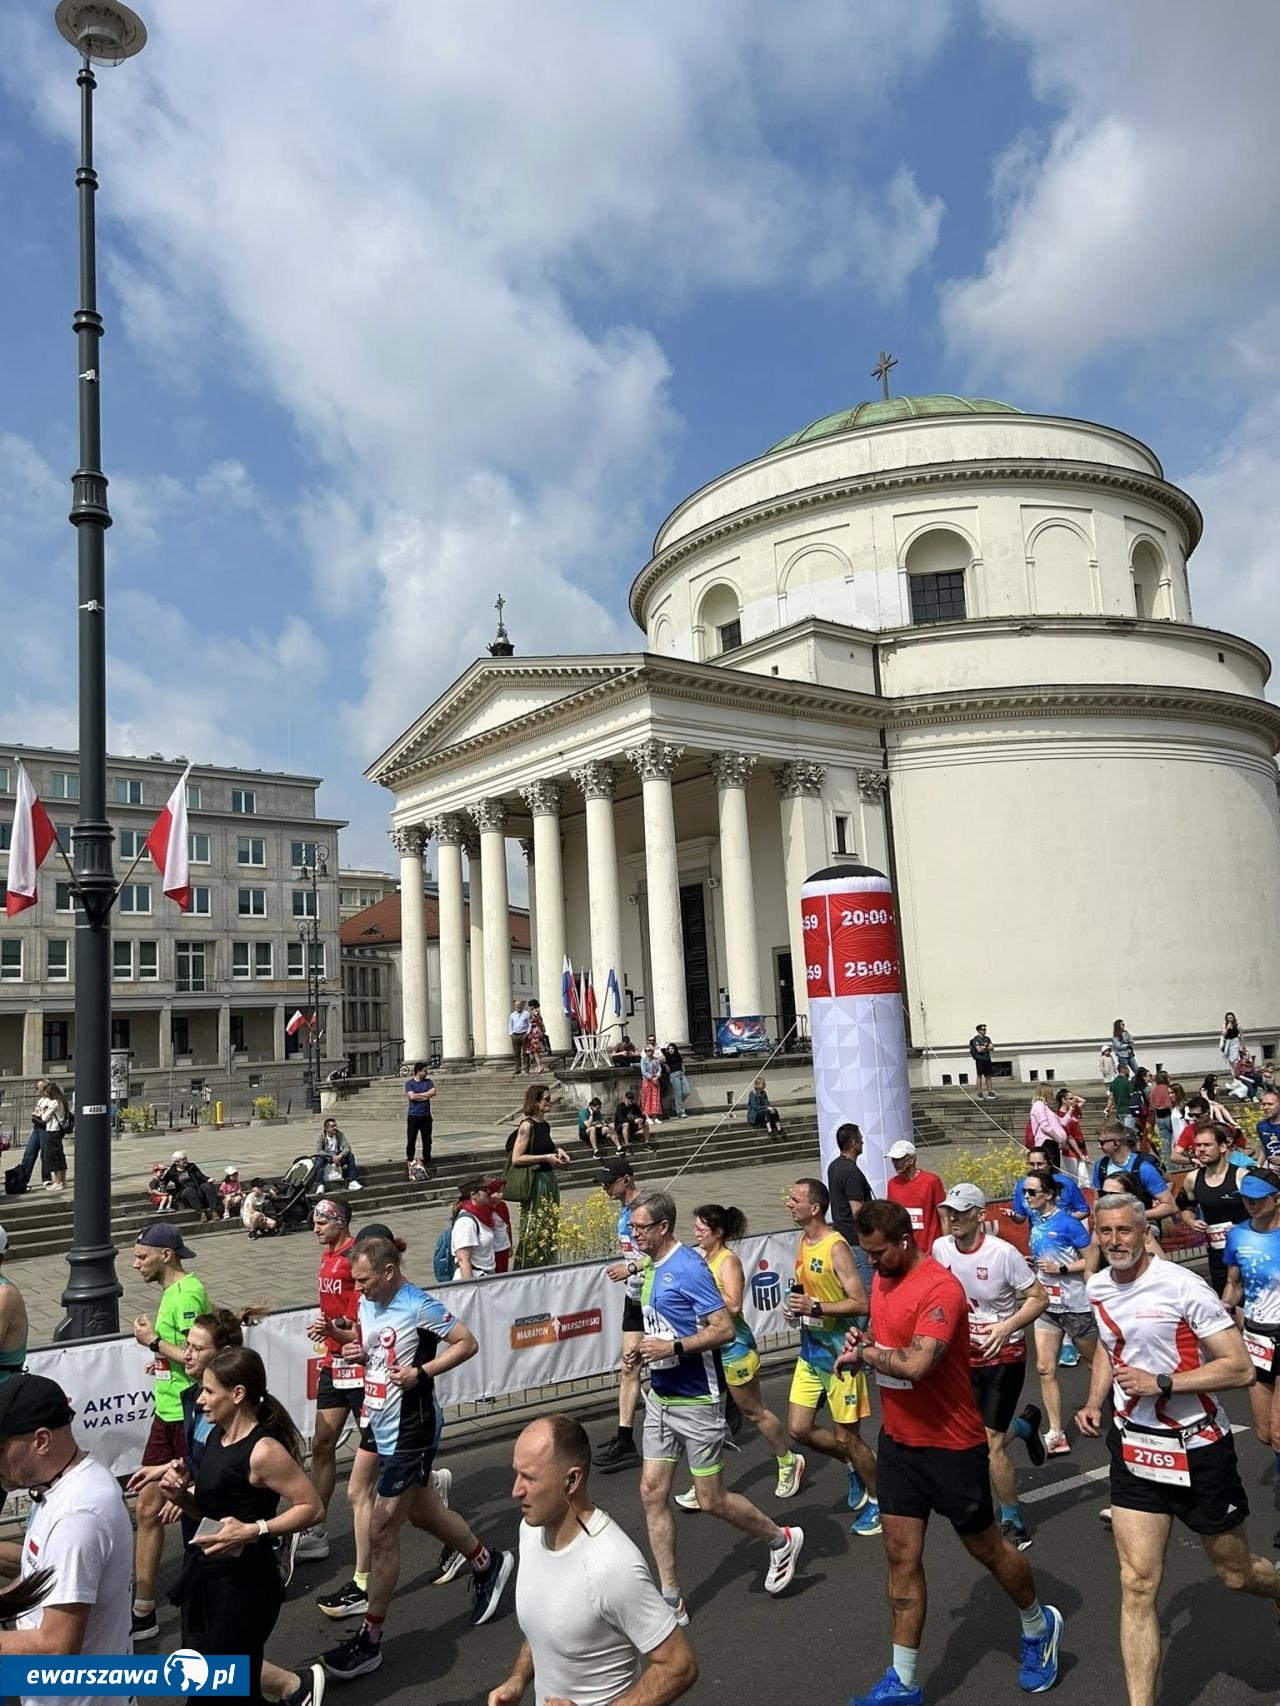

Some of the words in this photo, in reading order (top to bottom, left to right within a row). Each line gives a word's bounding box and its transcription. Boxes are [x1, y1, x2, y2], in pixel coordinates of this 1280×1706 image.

[517, 1326, 549, 1340] MARATON
[560, 1316, 600, 1333] WARSZAWSKI
[83, 1390, 156, 1415] AKTYW
[1133, 1449, 1175, 1467] 2769
